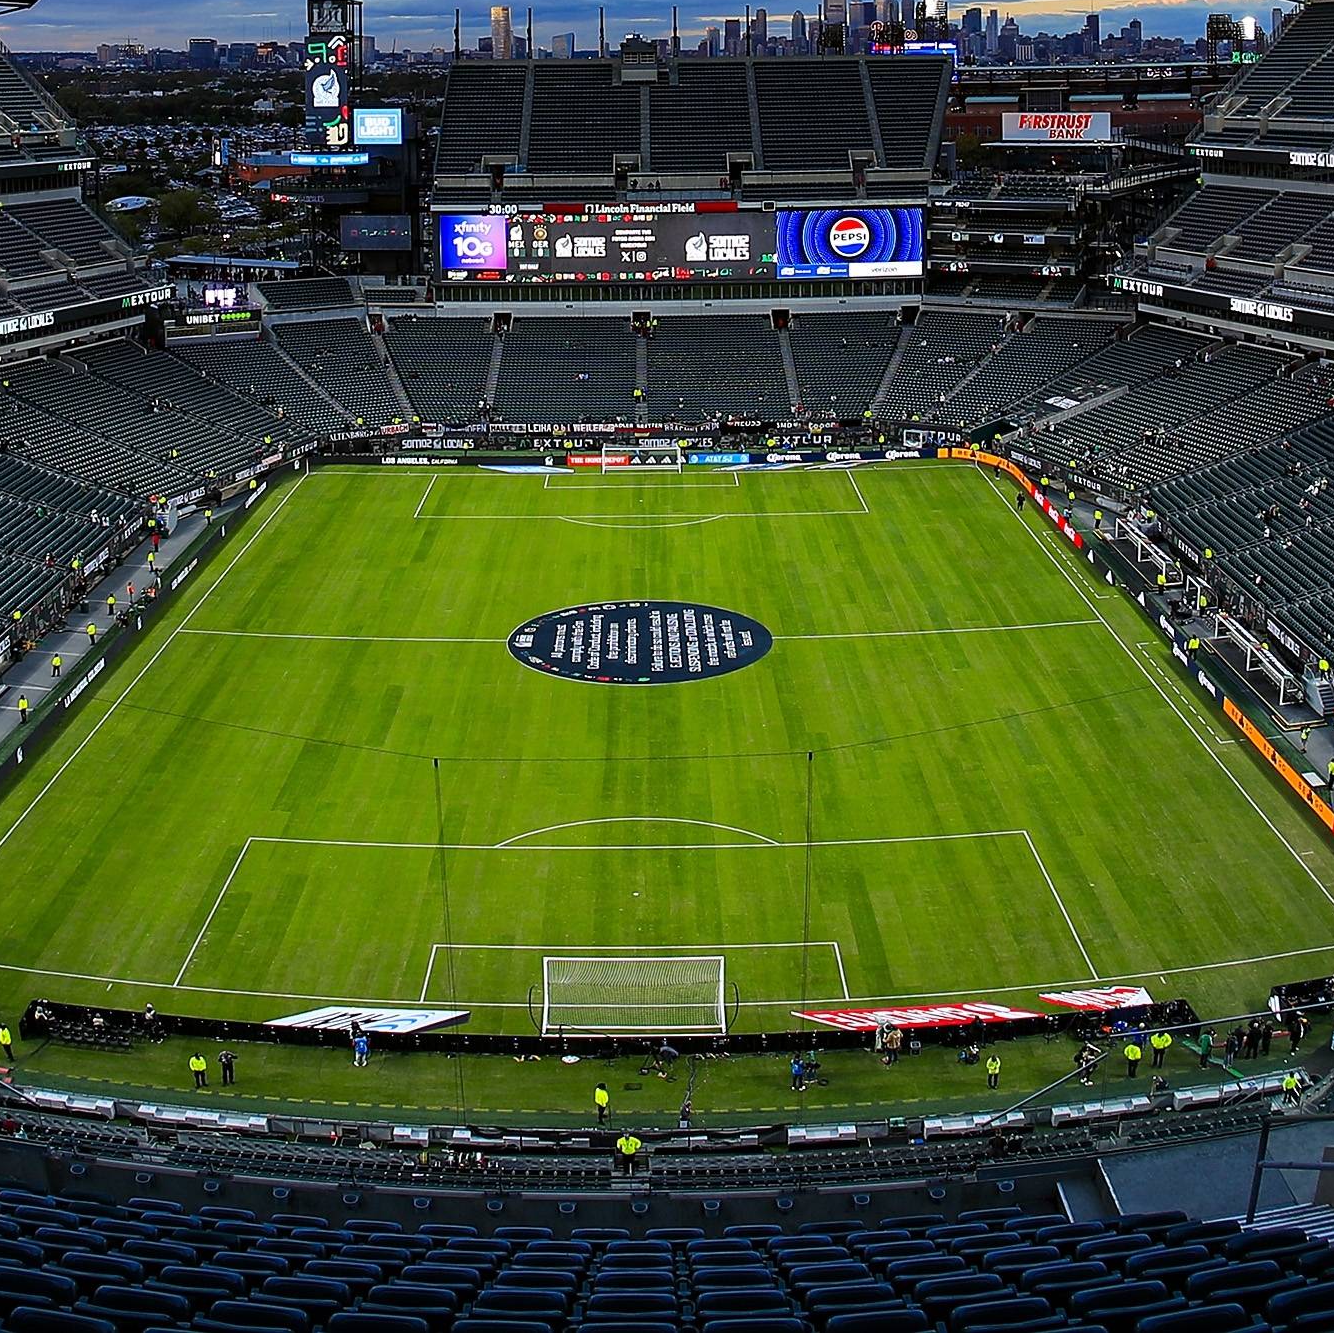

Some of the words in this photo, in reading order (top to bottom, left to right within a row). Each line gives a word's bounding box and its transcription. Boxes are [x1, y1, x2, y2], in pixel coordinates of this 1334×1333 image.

[365, 117, 390, 127] BUD
[1019, 114, 1093, 129] FIRSTRUST
[360, 126, 395, 136] LIGHT
[1049, 129, 1084, 139] BANK
[489, 205, 517, 215] 30:00
[595, 204, 629, 214] Lincoln
[630, 204, 671, 213] Financial
[672, 203, 694, 213] Field
[454, 220, 492, 235] xfinity
[833, 232, 867, 241] PEPSI
[453, 236, 493, 257] 10G
[508, 241, 525, 249] MEX
[532, 241, 549, 249] GER
[1113, 277, 1163, 297] MEXTOUR
[121, 288, 171, 308] MEXTOUR
[186, 313, 220, 325] UNIBET
[767, 453, 802, 463] Corona
[826, 451, 861, 463] Corona
[885, 449, 920, 460] Corona
